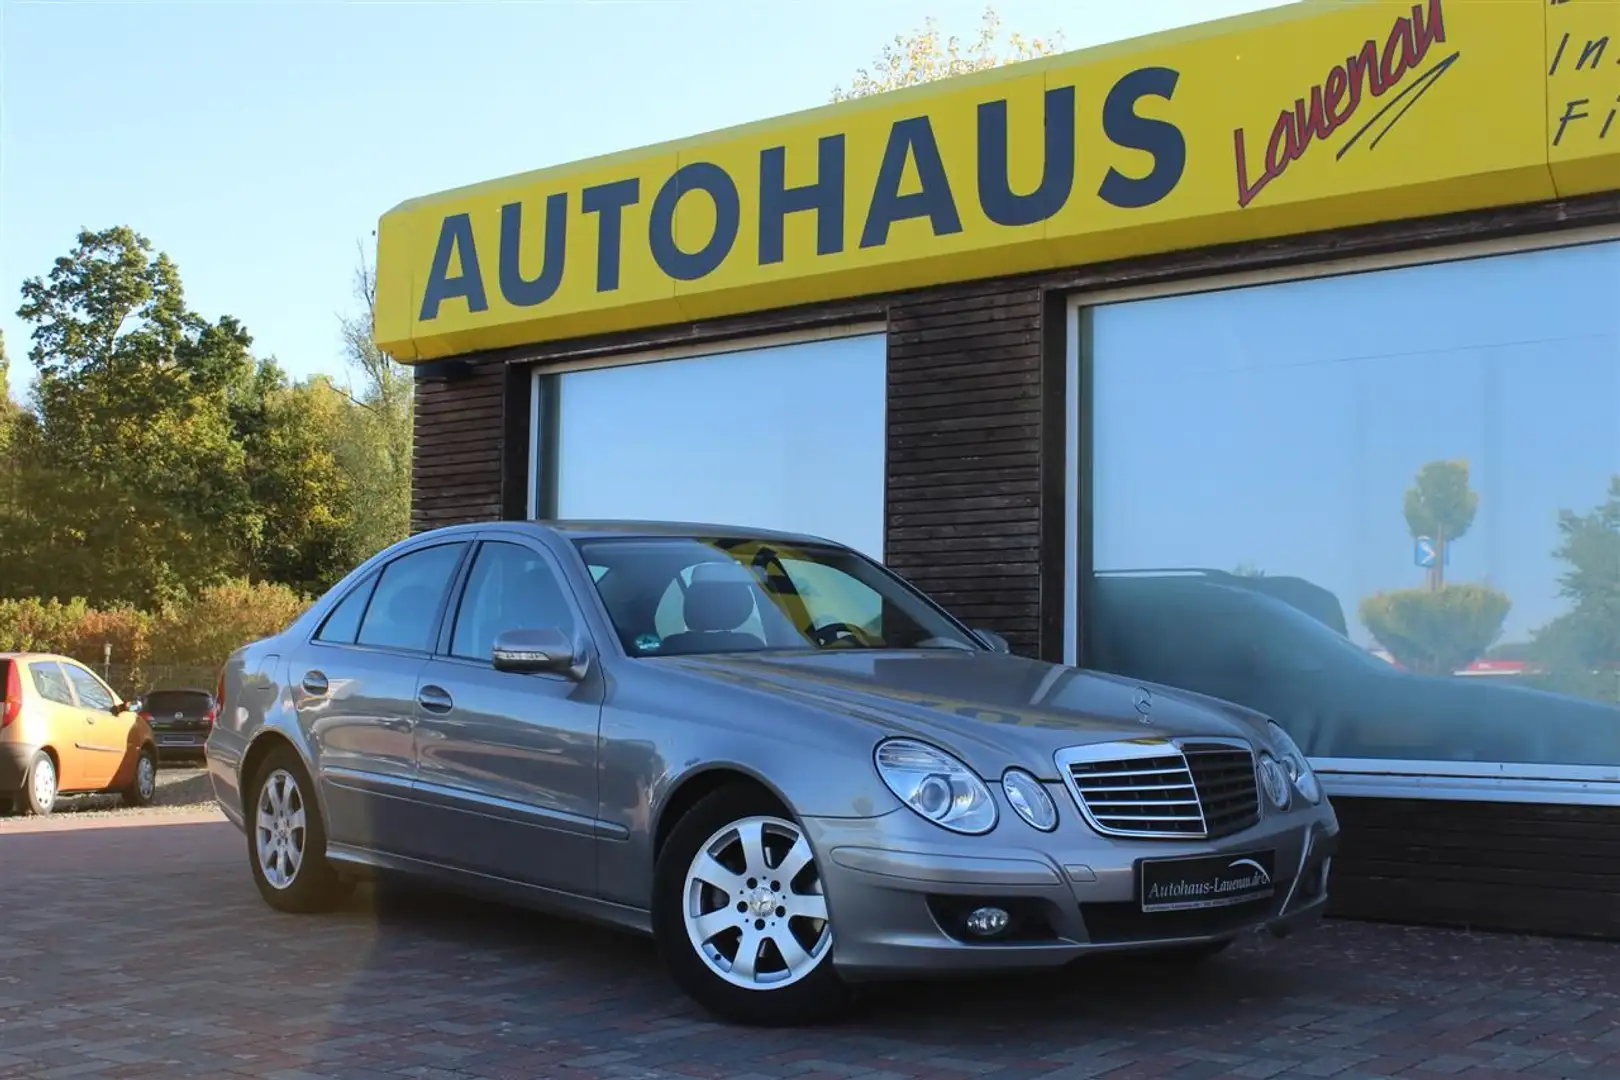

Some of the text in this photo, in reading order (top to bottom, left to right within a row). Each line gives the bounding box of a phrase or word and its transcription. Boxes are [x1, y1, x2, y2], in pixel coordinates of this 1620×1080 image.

[1549, 33, 1620, 76] In
[419, 0, 1445, 321] AUTOHAUS Lauenau
